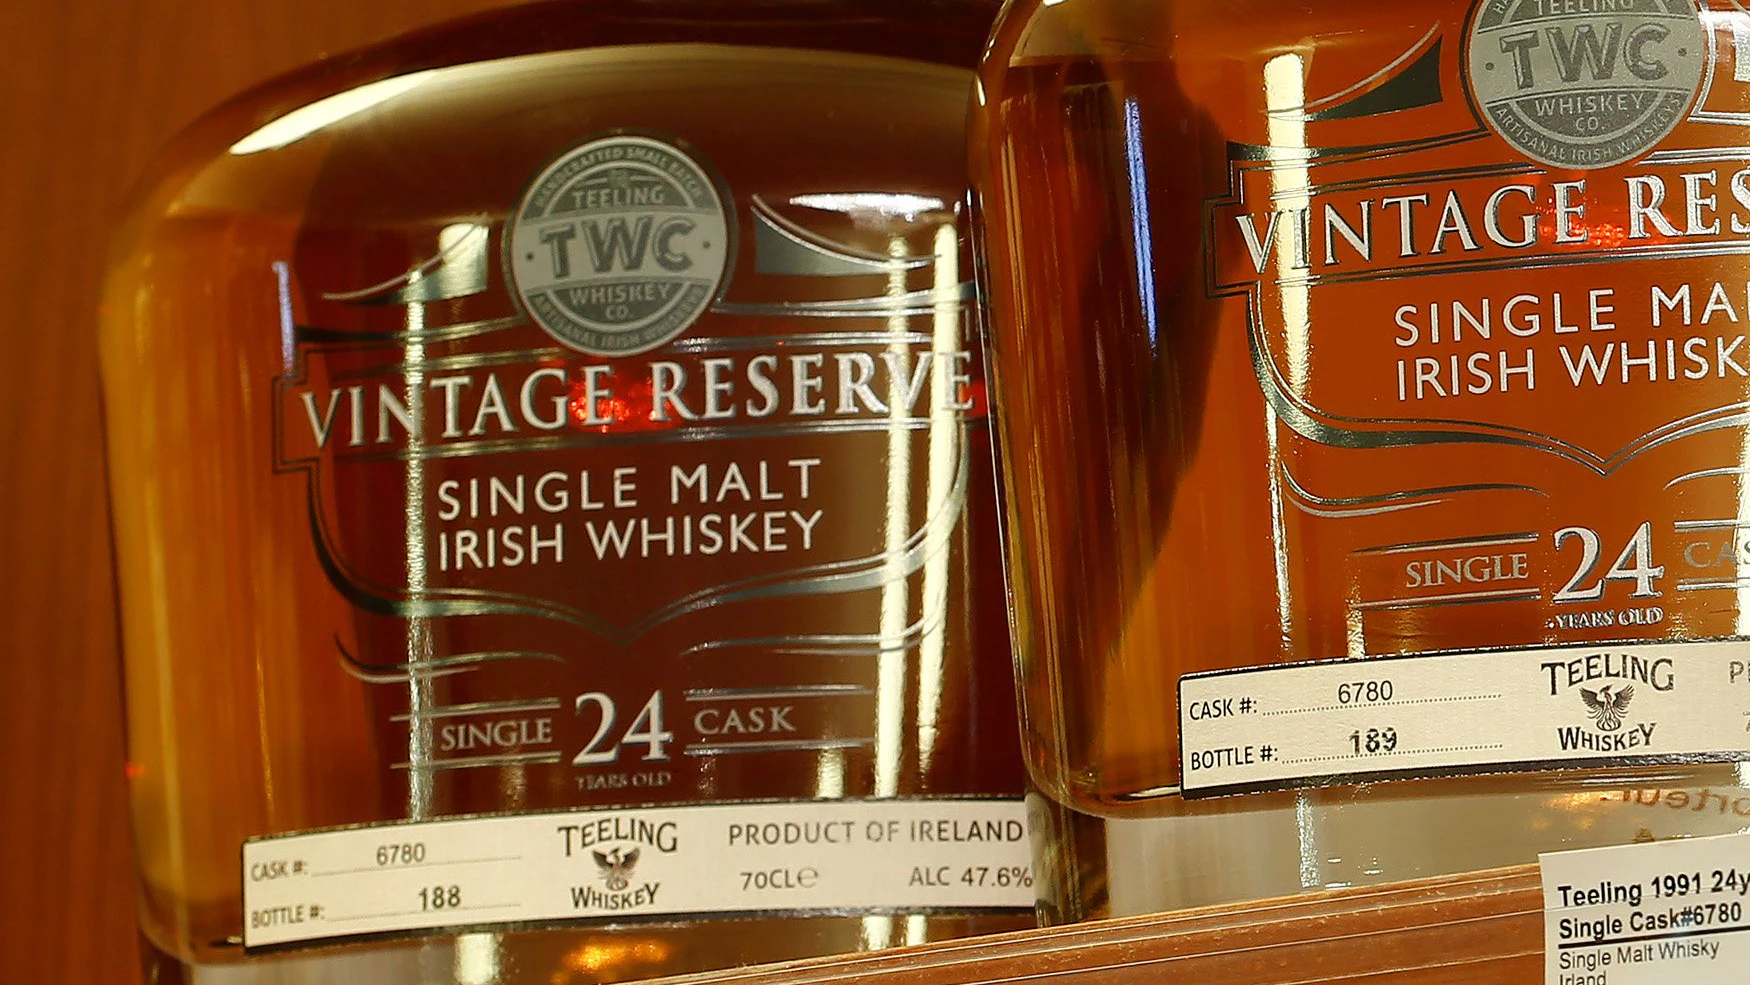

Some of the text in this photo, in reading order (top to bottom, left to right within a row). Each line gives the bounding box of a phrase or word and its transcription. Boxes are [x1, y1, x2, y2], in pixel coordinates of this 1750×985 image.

[1500, 22, 1671, 90] TWC
[1535, 93, 1644, 117] WHISKEY
[1576, 117, 1605, 131] CO.
[1497, 108, 1566, 160] ARTISANAL
[1572, 146, 1613, 162] IRISH
[572, 186, 665, 207] TEELING
[539, 217, 696, 278] TWC
[1236, 179, 1589, 276] VINTAGE
[570, 283, 672, 305] WHISKEY
[1395, 288, 1615, 347] SINGLE
[1397, 351, 1536, 402] IRISH
[300, 350, 975, 451] VINTAGE RESERVE
[437, 458, 822, 521] SINGLE MALT
[439, 509, 823, 571] IRISH WHISKEY
[1405, 553, 1530, 590] SINGLE
[1552, 522, 1665, 604] 24
[1555, 606, 1664, 629] YEARS OLD
[1541, 653, 1674, 695] TEELING
[1189, 680, 1394, 721] CASK #: 6780
[440, 689, 797, 765] SINGLE 24 CASK
[1557, 722, 1657, 752] WHISKEY
[1191, 727, 1398, 771] BOTTLE #: 189
[631, 771, 673, 787] OLD
[557, 818, 678, 857] TEELING
[728, 819, 1023, 846] PRODUCT OF IRELAND
[250, 861, 289, 882] CASK
[376, 842, 426, 866] 6780
[909, 867, 950, 888] ALC
[960, 867, 1034, 889] 47.6%
[250, 909, 305, 929] BOTTLE
[418, 885, 461, 912] 188
[570, 883, 662, 912] WHISKEY
[1558, 880, 1643, 907] Teeling
[1650, 873, 1701, 897] 1991
[1559, 902, 1742, 943] Single Cask#6780
[1559, 939, 1720, 972] Single Malt Whisky
[1559, 971, 1607, 985] Irland
